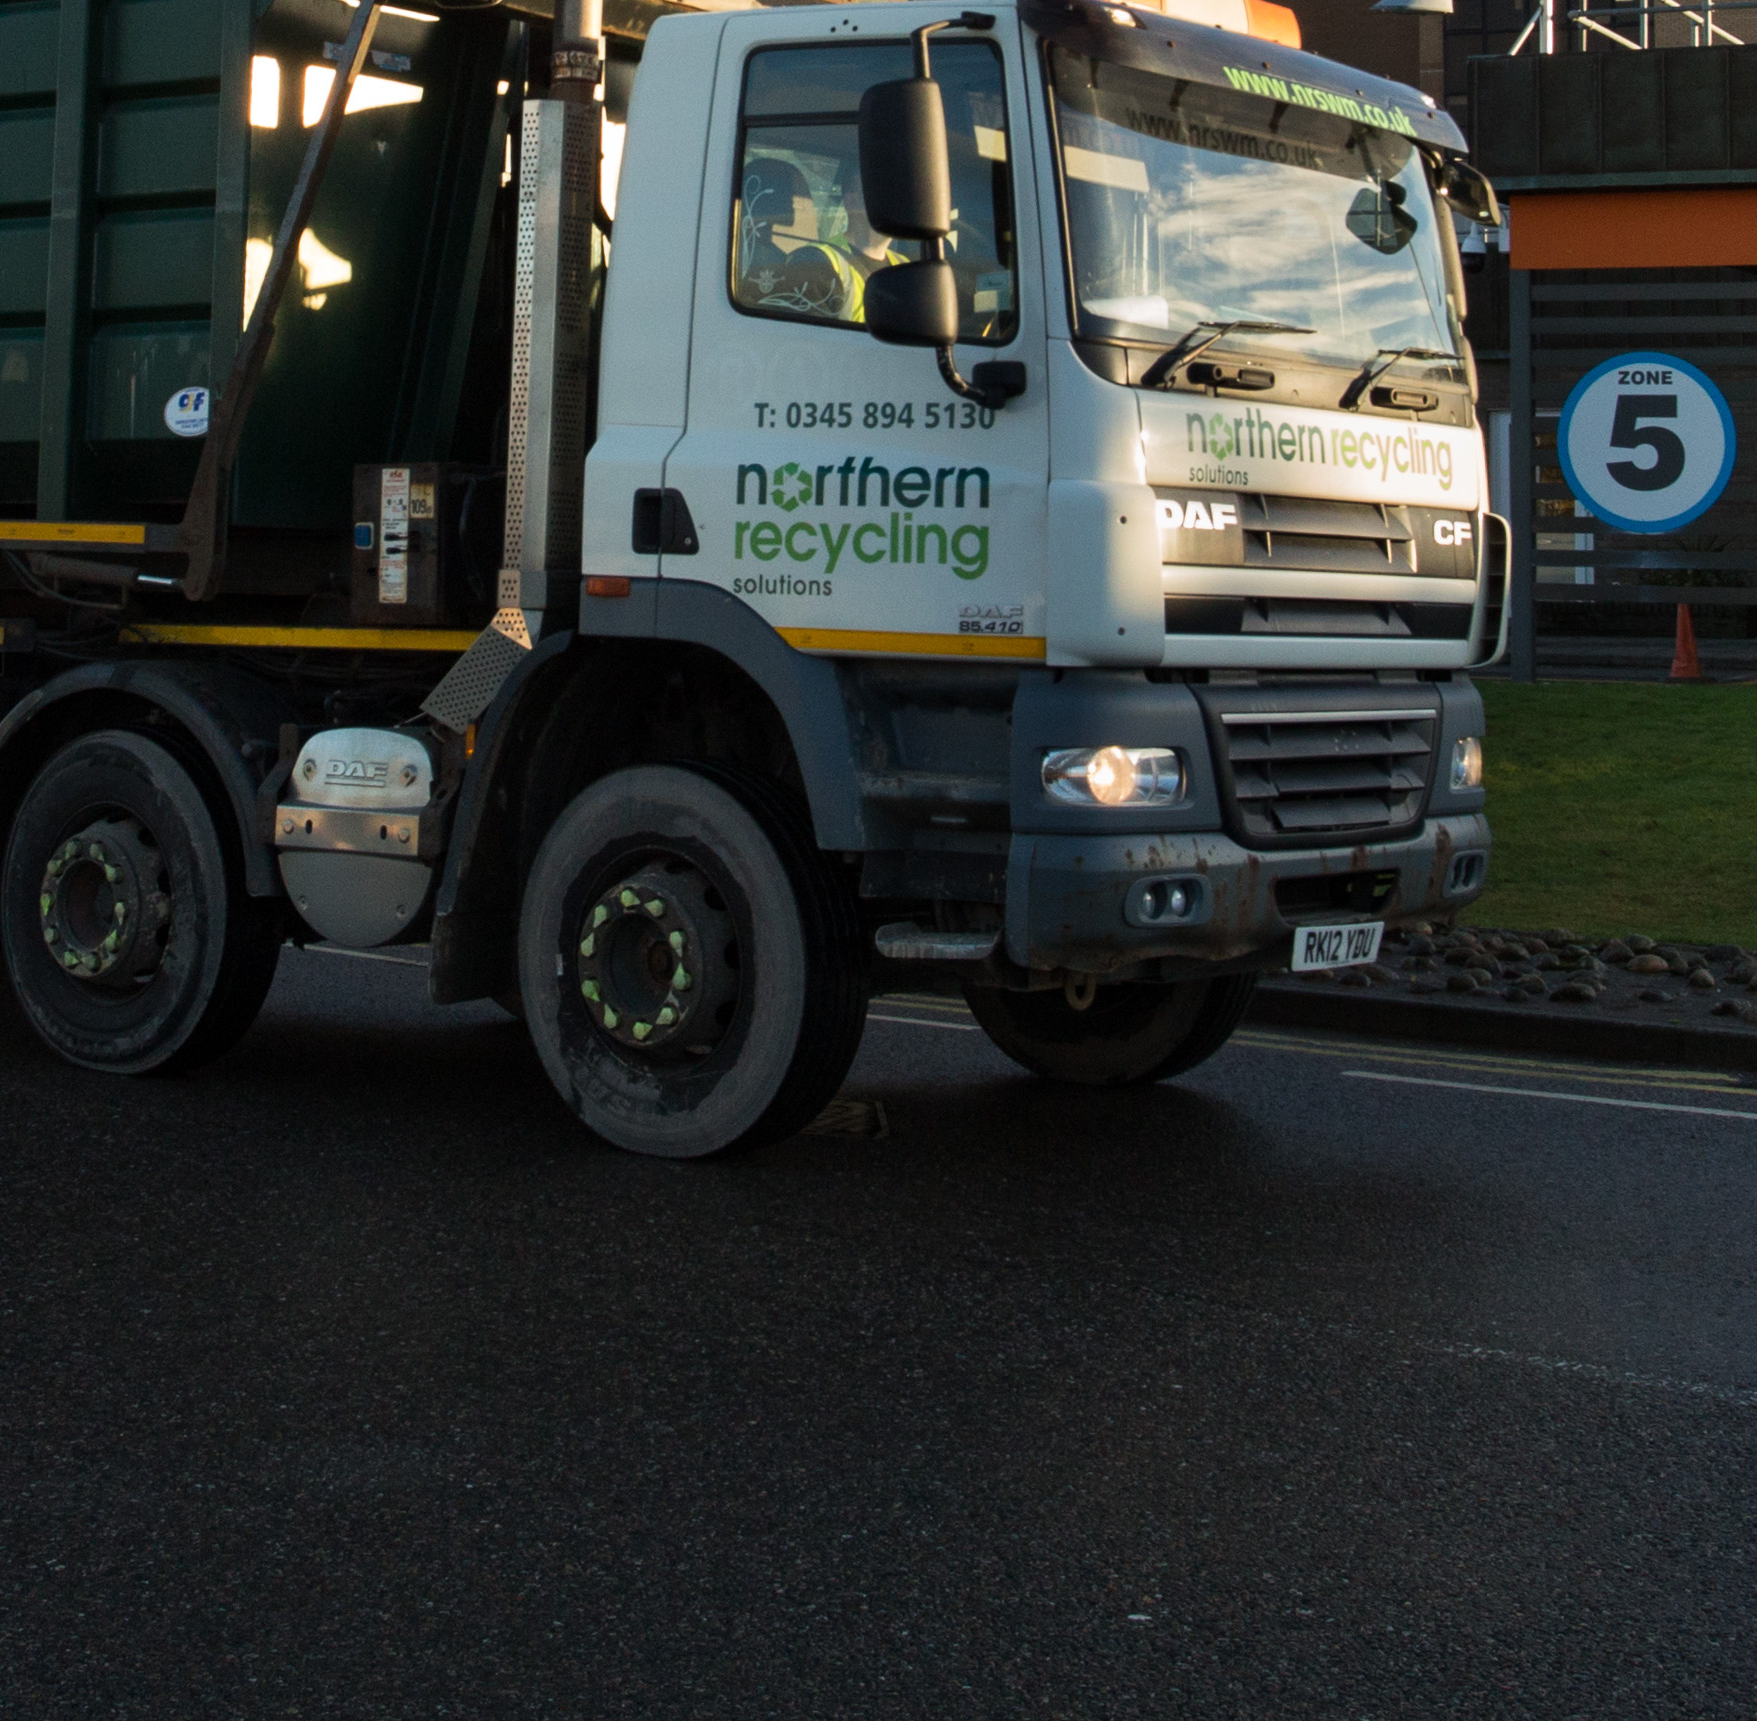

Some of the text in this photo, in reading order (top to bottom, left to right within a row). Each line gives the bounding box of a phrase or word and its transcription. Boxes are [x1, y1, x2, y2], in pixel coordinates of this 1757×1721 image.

[1223, 65, 1417, 136] www.nrswm.co.uk
[1618, 370, 1673, 386] ZONE
[754, 402, 995, 430] T: 0345 894 5130
[1186, 407, 1454, 491] northern recycling
[1606, 394, 1686, 492] 5
[736, 456, 990, 513] northern
[1188, 464, 1249, 486] solutions
[1154, 499, 1238, 530] DAF
[734, 512, 990, 580] recycling
[1433, 519, 1472, 546] CF
[733, 574, 833, 596] solutions
[959, 605, 1024, 619] DAF
[959, 620, 1022, 633] 85.410
[325, 759, 389, 780] DAF
